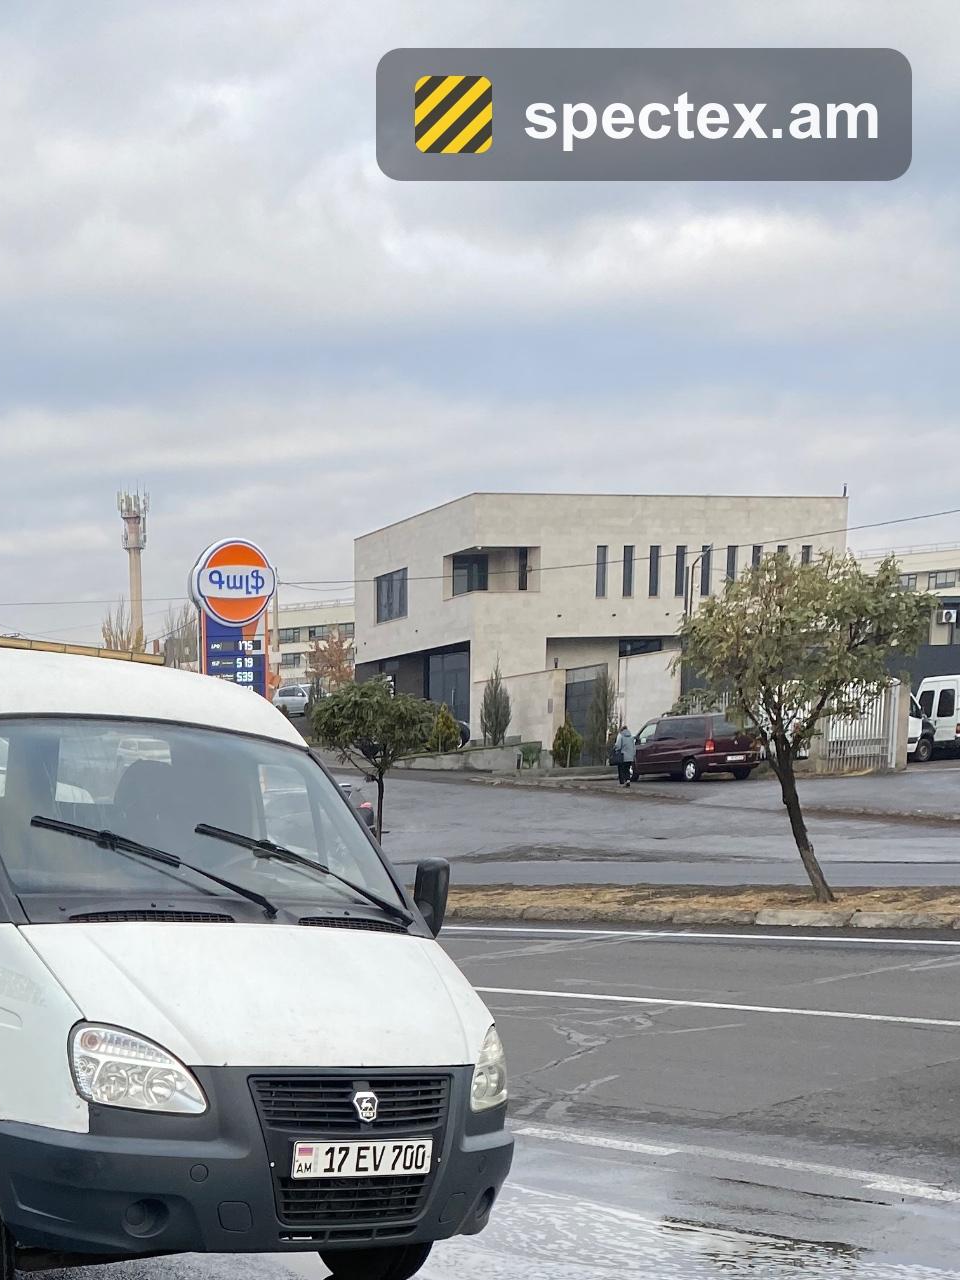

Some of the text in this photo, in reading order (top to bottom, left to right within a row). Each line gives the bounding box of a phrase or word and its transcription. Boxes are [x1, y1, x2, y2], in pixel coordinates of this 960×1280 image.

[208, 569, 265, 595] Գալֆ
[238, 640, 253, 651] 175
[236, 671, 254, 682] 539
[295, 1143, 426, 1174] AM 17 EV 700
